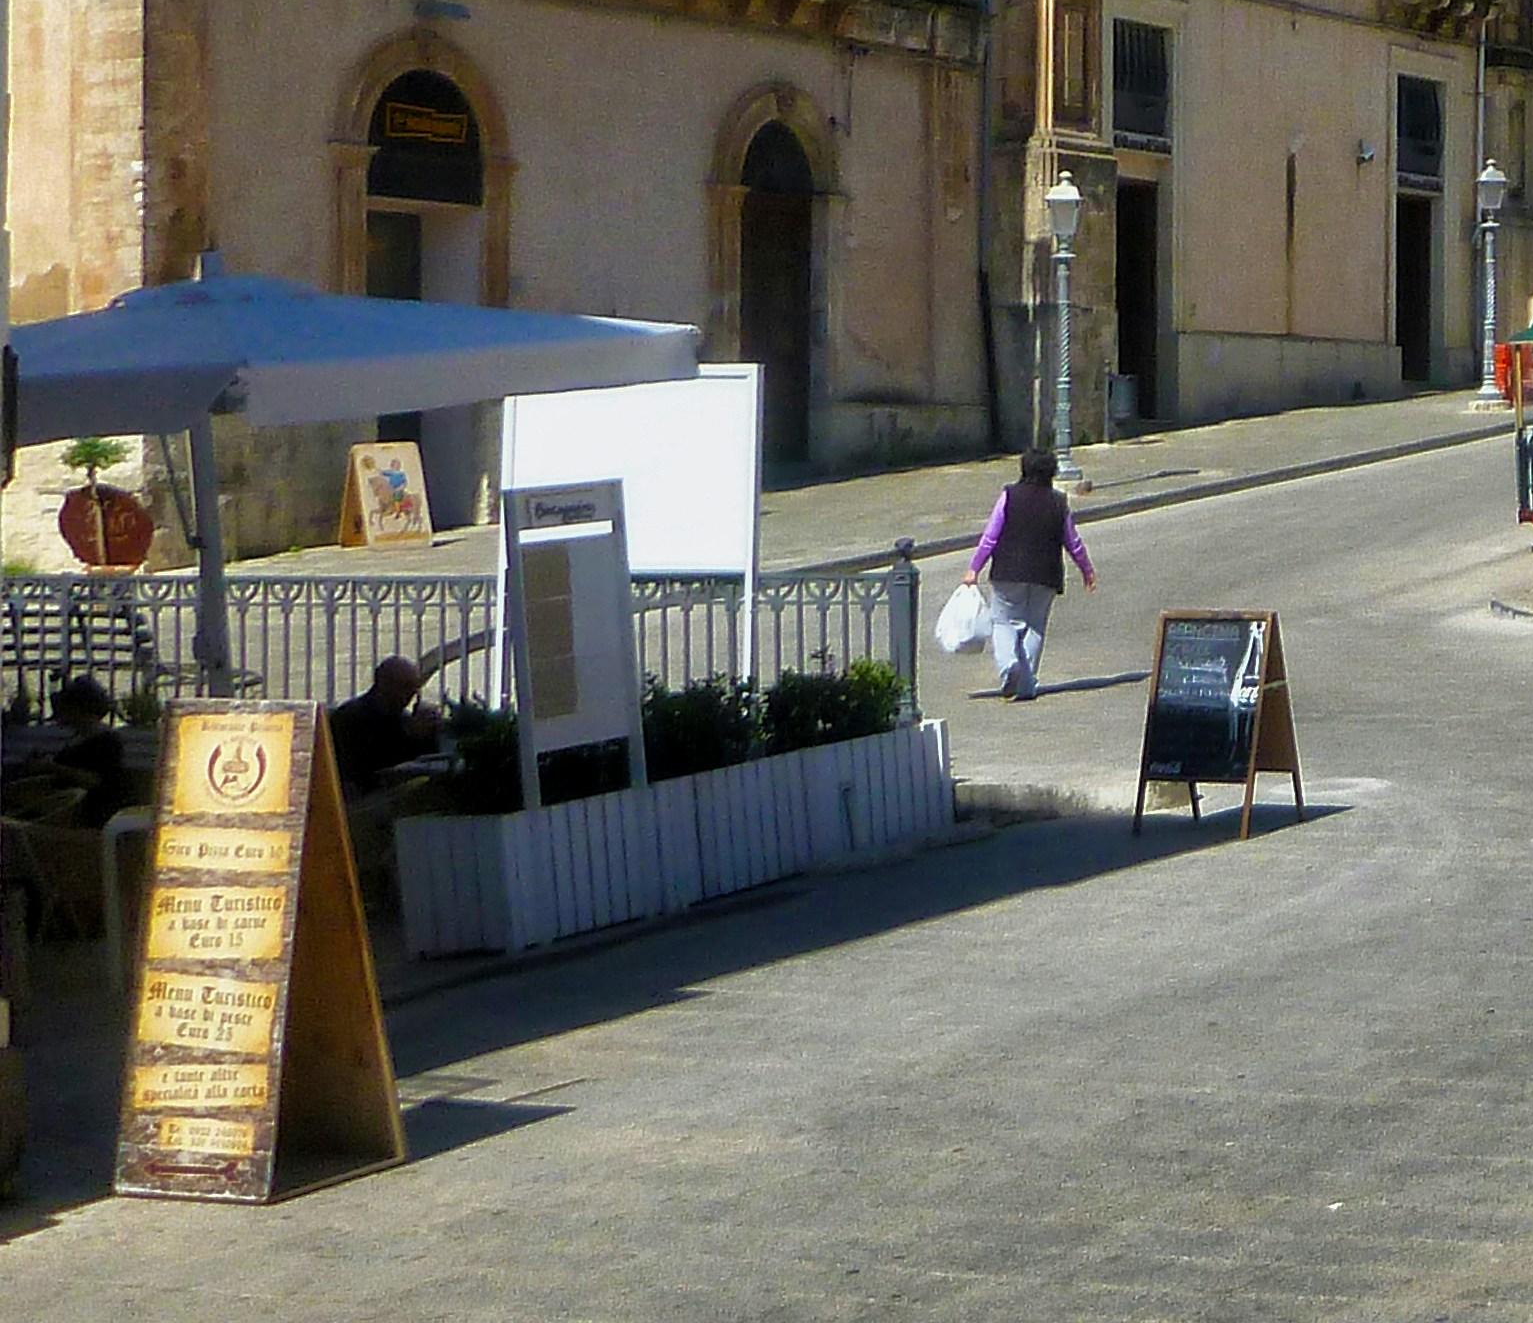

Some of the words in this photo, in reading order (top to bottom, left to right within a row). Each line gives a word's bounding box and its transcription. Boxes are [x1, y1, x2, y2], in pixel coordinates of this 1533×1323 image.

[234, 844, 265, 858] Euro
[156, 896, 202, 915] Menu
[210, 894, 283, 913] Turistico
[182, 917, 210, 930] base
[234, 916, 268, 930] carne
[189, 933, 224, 949] Euro
[147, 981, 194, 1001] Menu
[201, 986, 273, 1010] Turistico
[169, 1005, 197, 1021] base
[220, 1011, 253, 1027] pesce
[176, 1022, 210, 1039] Euro
